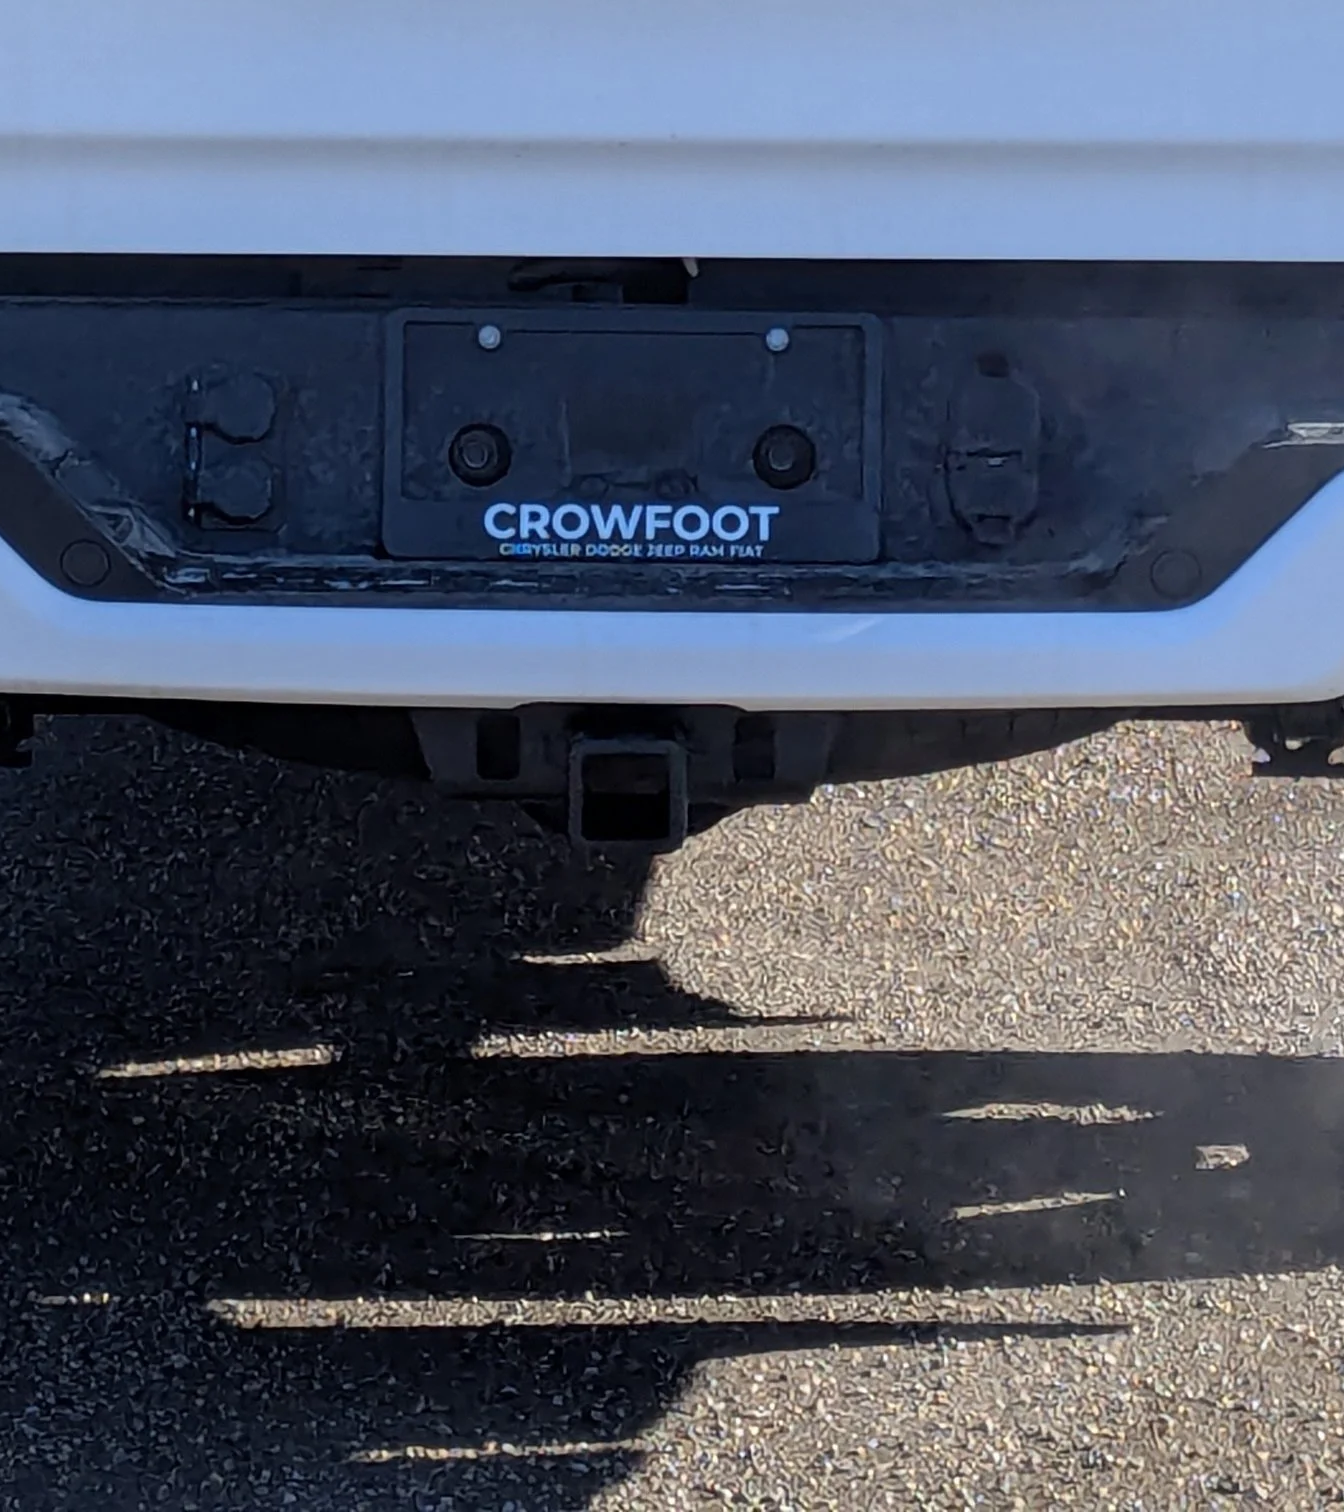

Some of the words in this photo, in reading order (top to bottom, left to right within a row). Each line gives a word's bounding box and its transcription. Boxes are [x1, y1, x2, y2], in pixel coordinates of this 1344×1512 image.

[483, 502, 780, 542] CROWFOOT
[499, 543, 581, 557] CHRYSLER
[585, 543, 643, 557] DODGE
[647, 543, 685, 557] JEEP
[689, 543, 724, 557] RAM
[730, 544, 765, 558] FIAT
